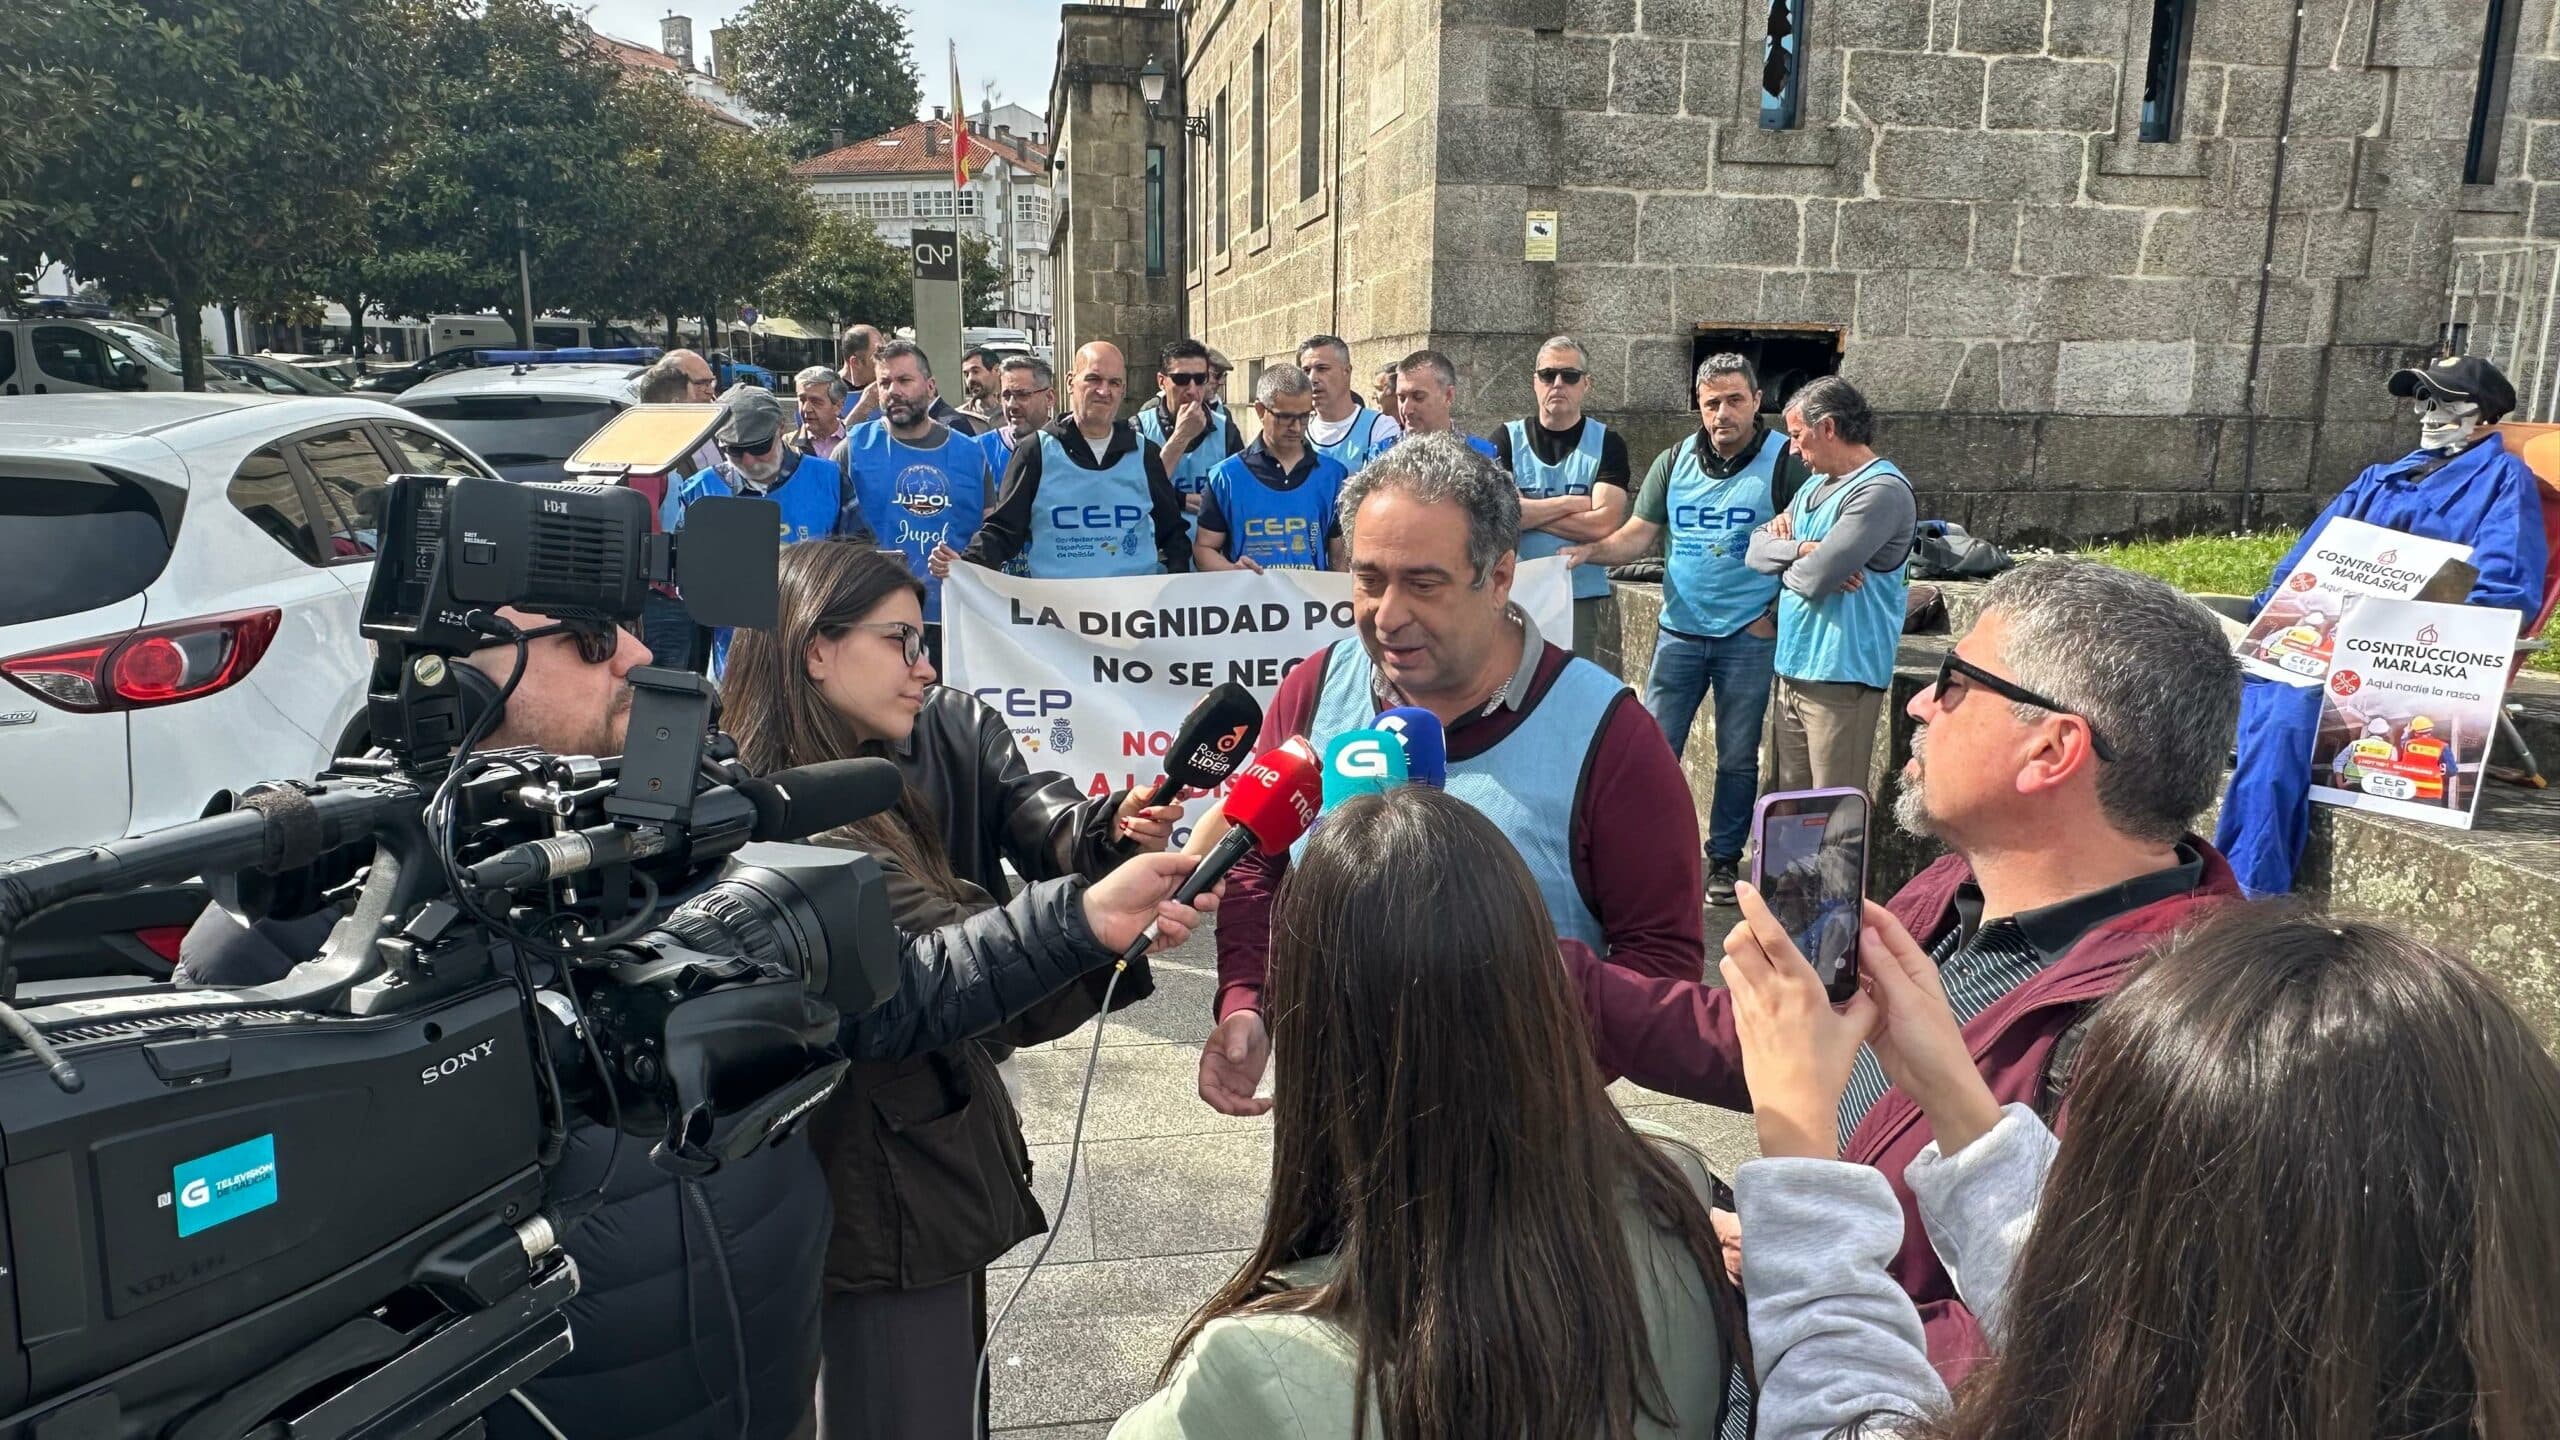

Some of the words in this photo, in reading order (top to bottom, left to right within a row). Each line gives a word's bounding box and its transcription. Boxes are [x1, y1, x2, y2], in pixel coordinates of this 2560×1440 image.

[915, 243, 953, 265] CNP
[892, 493, 952, 507] JUPOL
[1052, 505, 1142, 529] CEP
[1245, 517, 1306, 536] CEP
[1676, 505, 1756, 530] CEP
[895, 519, 949, 555] Jupol
[2316, 549, 2428, 584] COSNTRUCCION
[2331, 566, 2409, 593] MARLASKA
[1011, 598, 1065, 629] LA
[1079, 603, 1290, 639] DIGNIDAD
[1304, 601, 1356, 631] PO
[2346, 638, 2505, 668] COSNTRUCCIONES
[1093, 655, 1153, 683] NO
[1169, 661, 1213, 687] SE
[2372, 655, 2468, 680] MARLASKA
[2395, 683, 2429, 694] nadie
[2432, 686, 2443, 696] la
[2445, 690, 2481, 701] rasca
[1123, 731, 1173, 756] NO
[1088, 773, 1111, 797] A
[2373, 776, 2407, 787] CEP
[1289, 790, 1314, 828] rne
[421, 1038, 495, 1085] SONY
